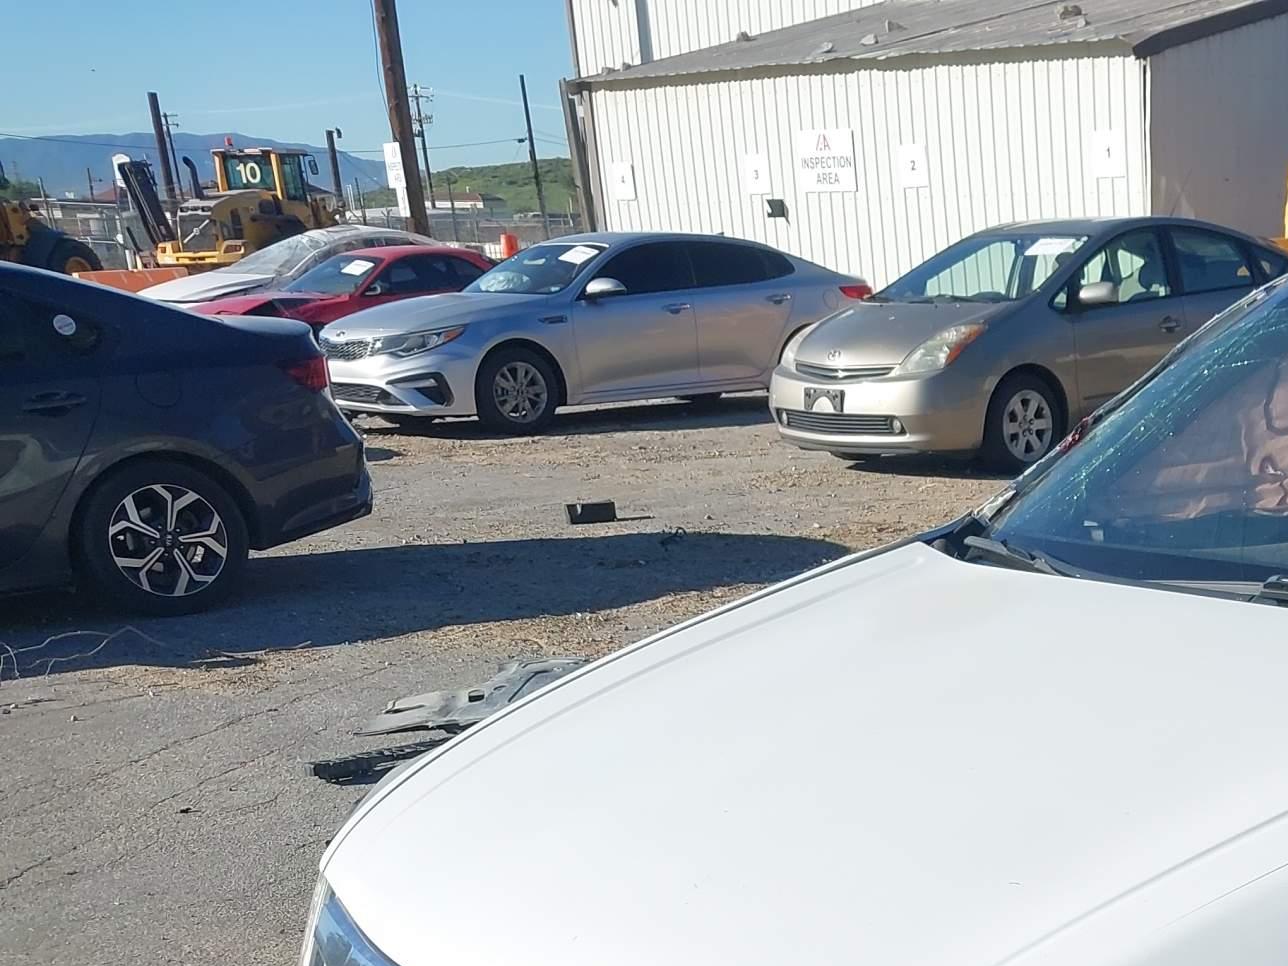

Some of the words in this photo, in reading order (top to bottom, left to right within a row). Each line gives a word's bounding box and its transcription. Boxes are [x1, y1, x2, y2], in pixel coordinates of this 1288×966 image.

[801, 154, 852, 169] INSPECTION
[910, 160, 917, 171] 2
[236, 162, 261, 183] 10
[816, 171, 841, 184] AREA
